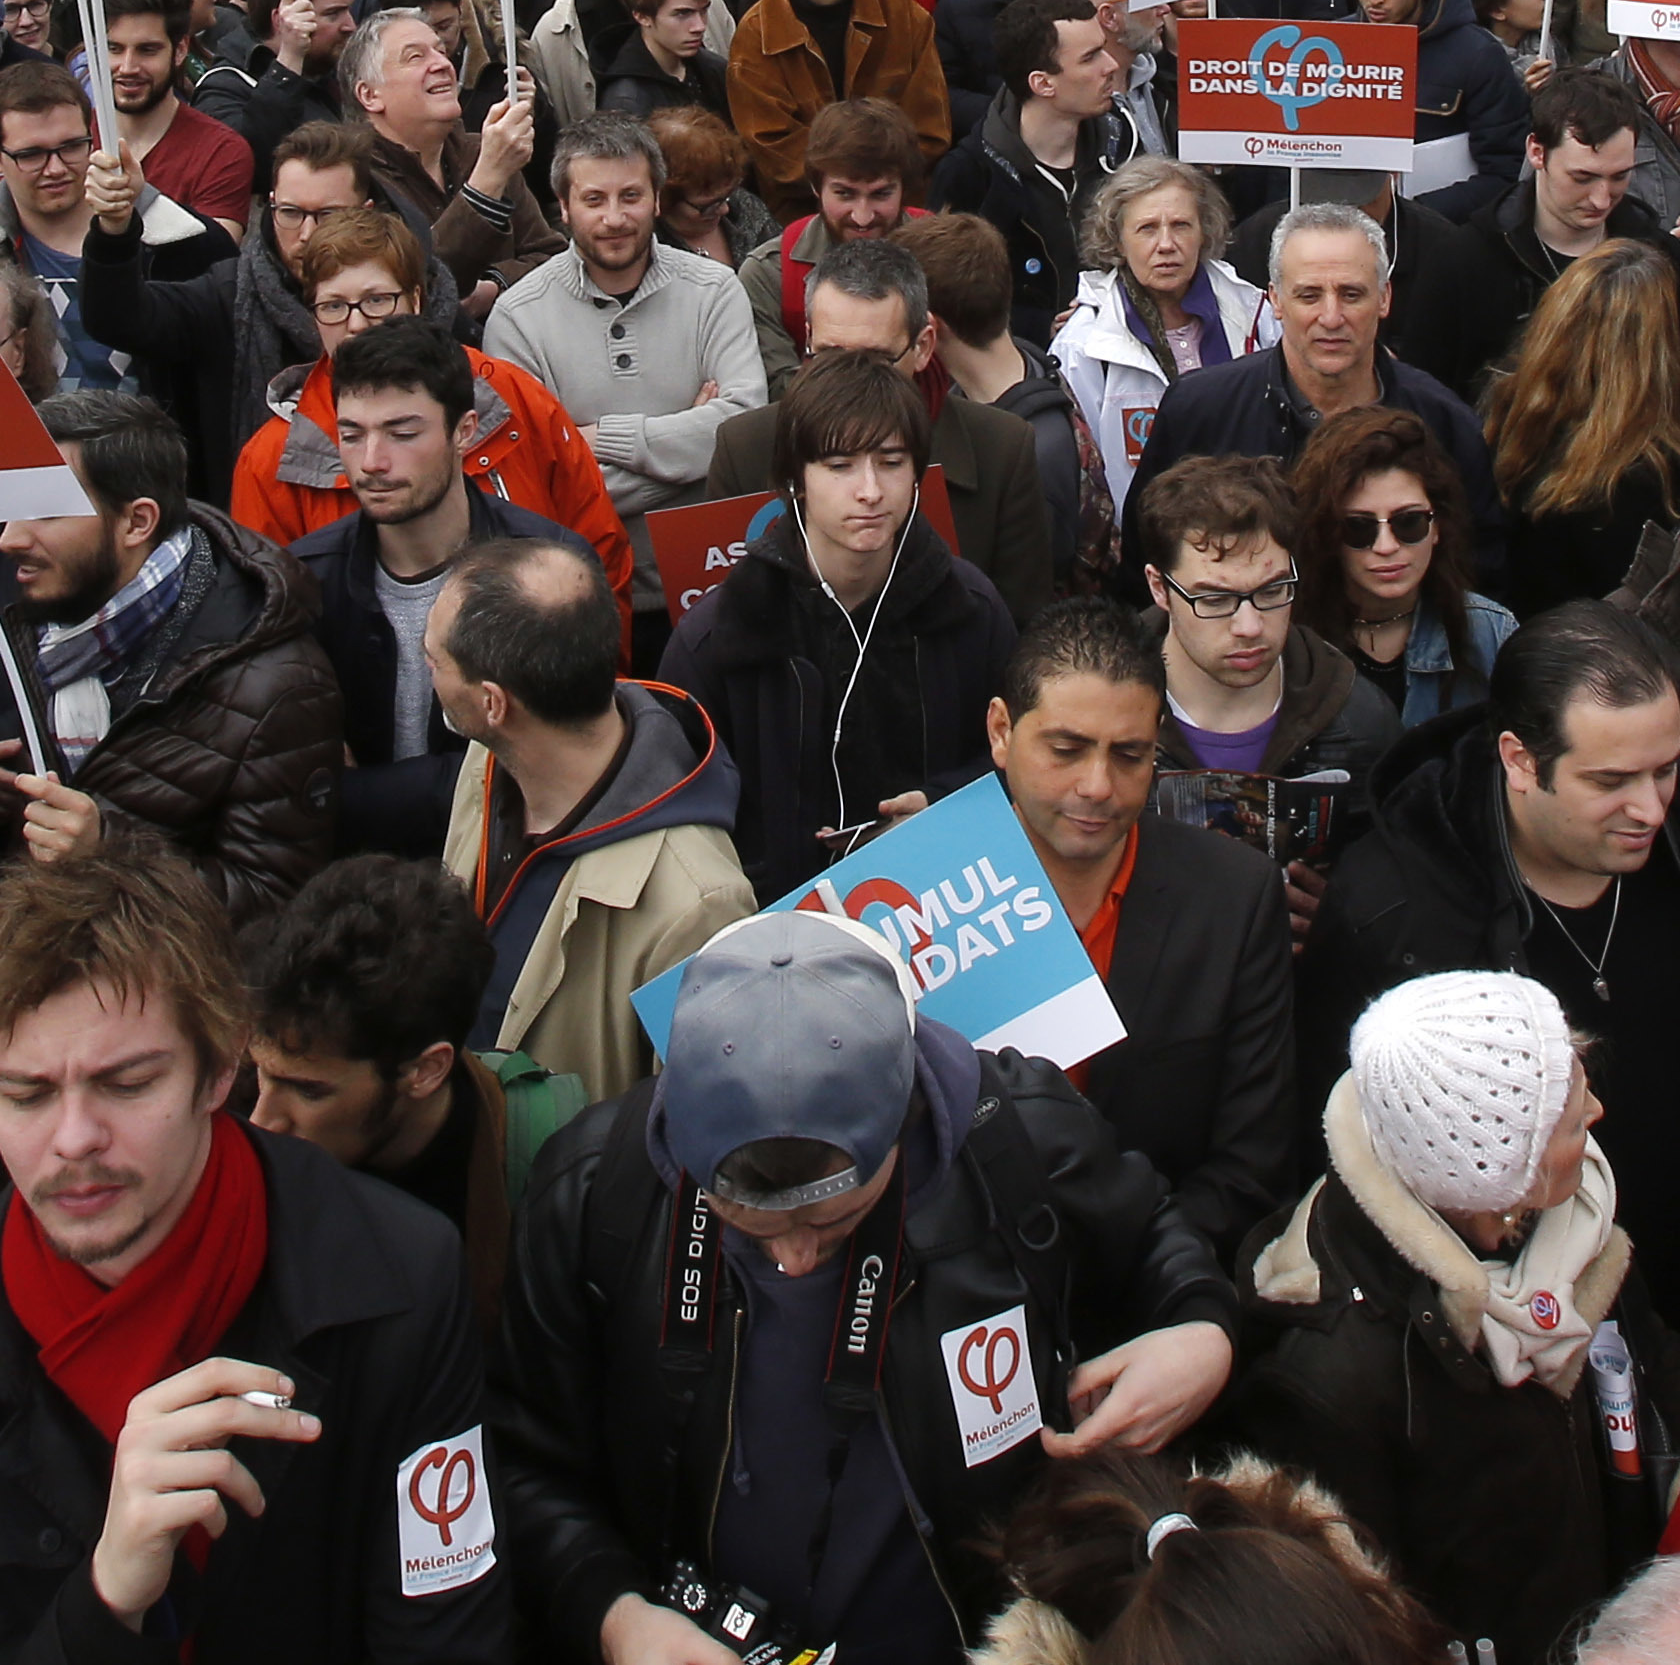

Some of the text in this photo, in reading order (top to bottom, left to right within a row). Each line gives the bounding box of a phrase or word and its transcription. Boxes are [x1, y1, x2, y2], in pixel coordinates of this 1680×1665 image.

[1188, 60, 1405, 81] DROIT DE MOURIR
[1189, 78, 1403, 100] DANS LA DIGNITÉ
[1266, 139, 1343, 152] Mélenchon
[879, 856, 1018, 953] UMUL
[680, 1267, 703, 1322] EOS
[847, 1254, 884, 1354] Canon
[964, 1400, 1035, 1448] Mélenchon
[404, 1539, 492, 1575] Mélenchon
